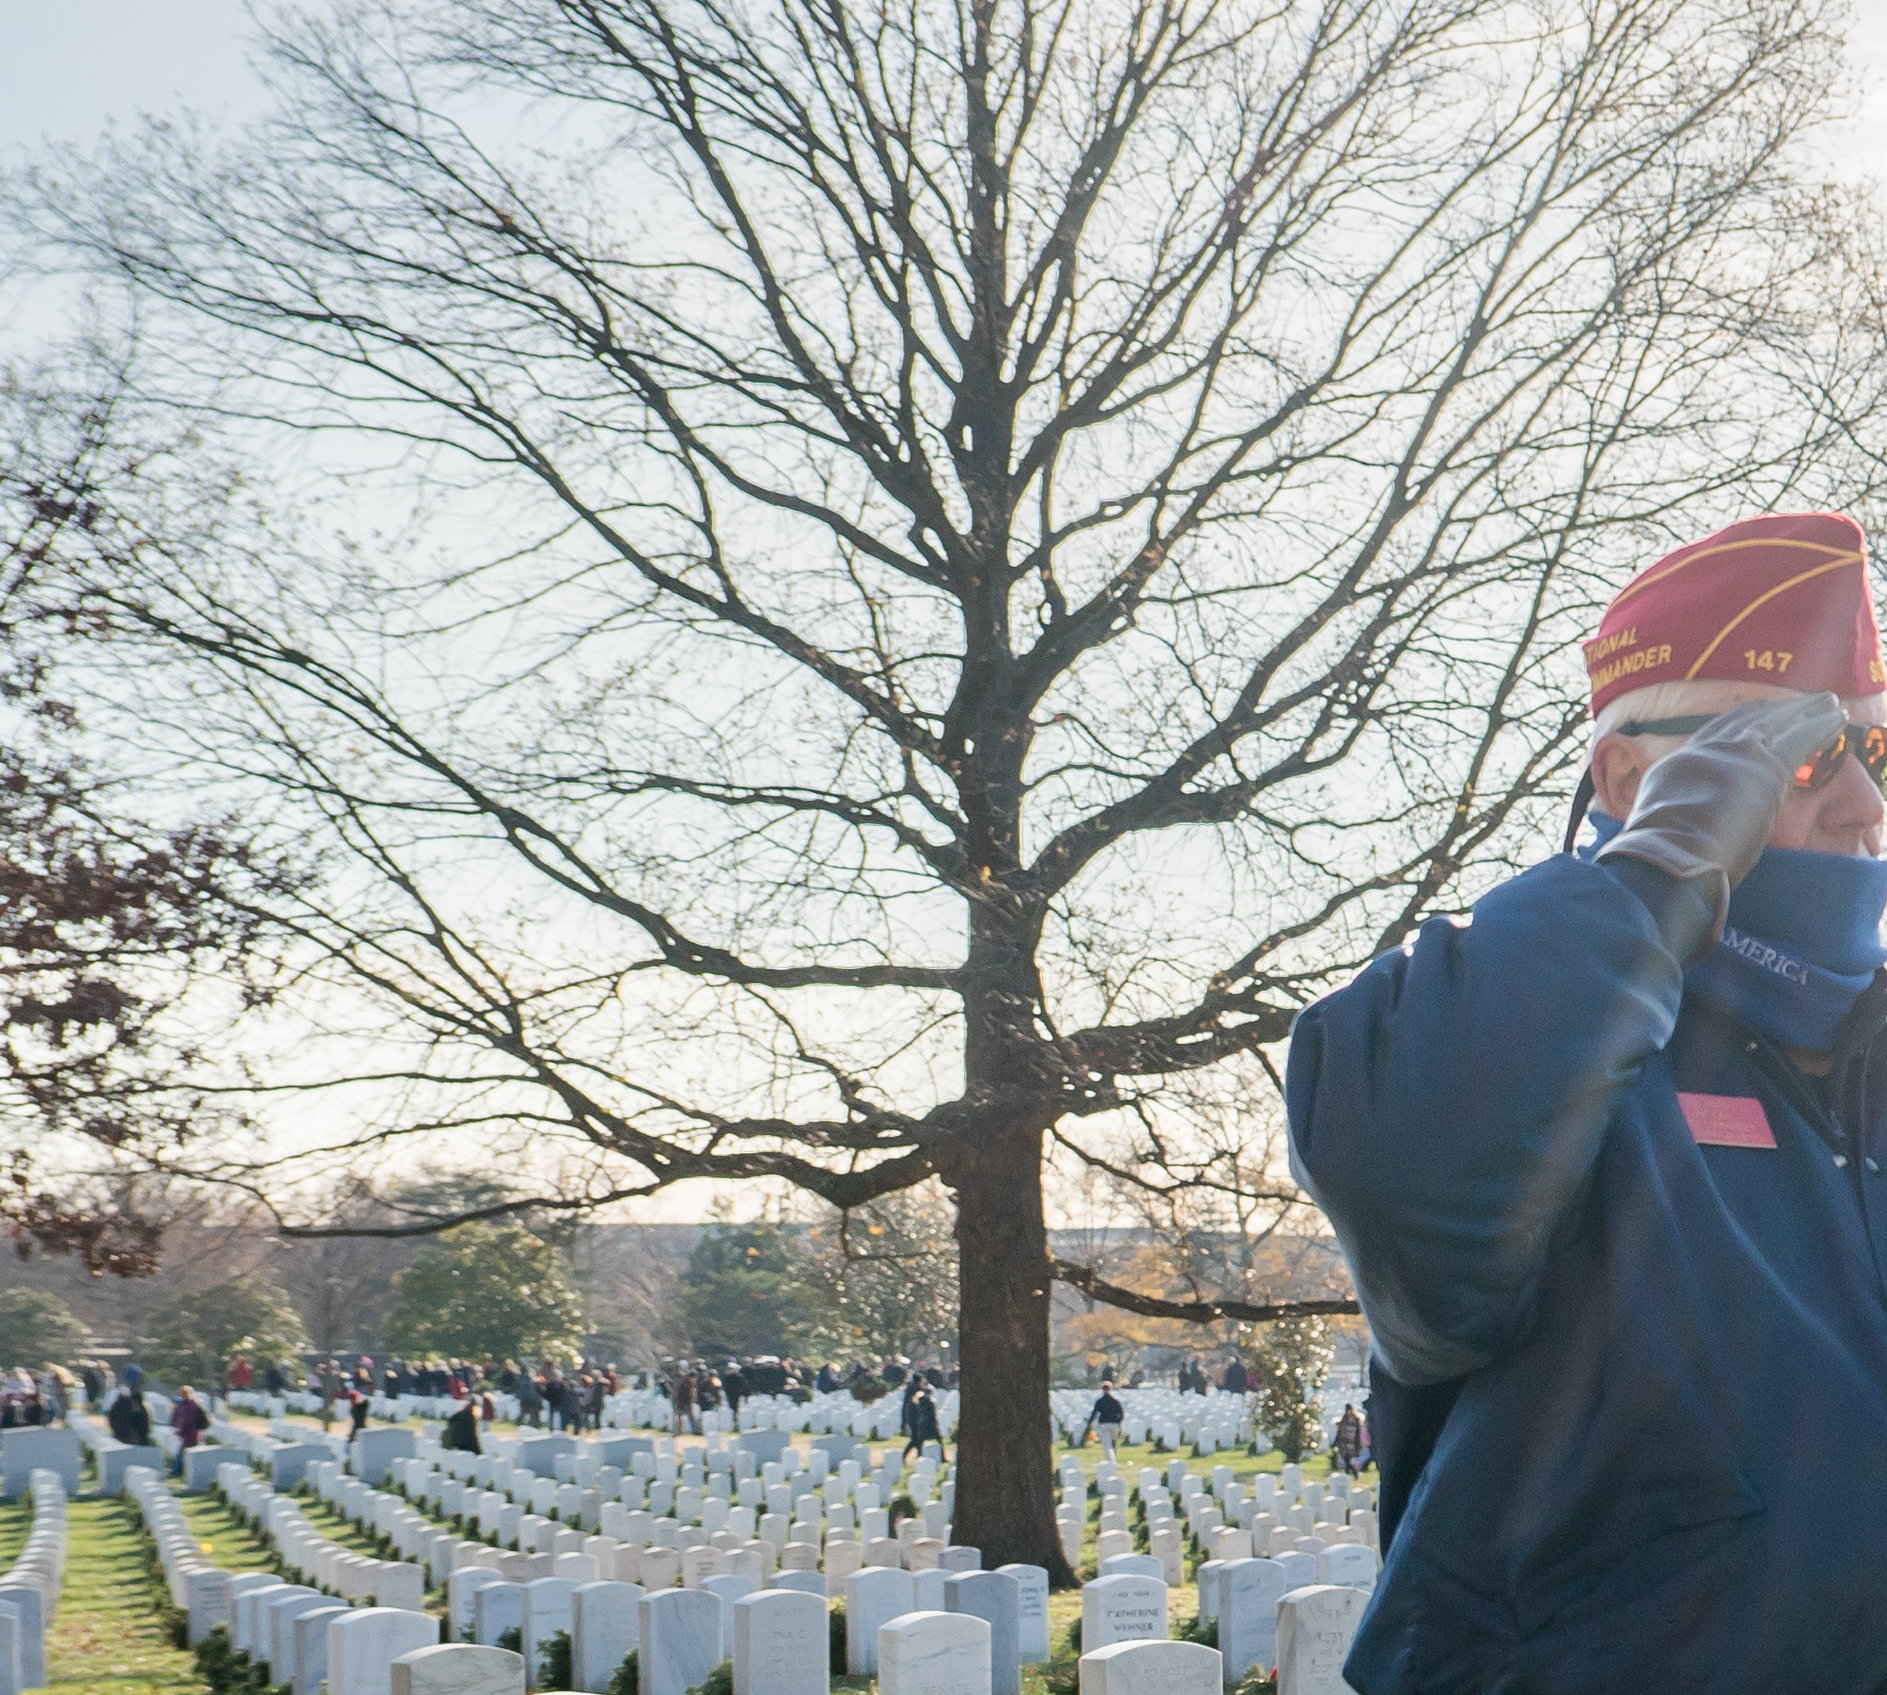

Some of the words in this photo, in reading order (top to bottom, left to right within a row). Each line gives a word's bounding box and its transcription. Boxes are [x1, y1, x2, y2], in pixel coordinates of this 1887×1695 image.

[1586, 626, 1639, 664] TIONAL
[1744, 649, 1794, 673] 147
[1719, 926, 1808, 986] MERIC
